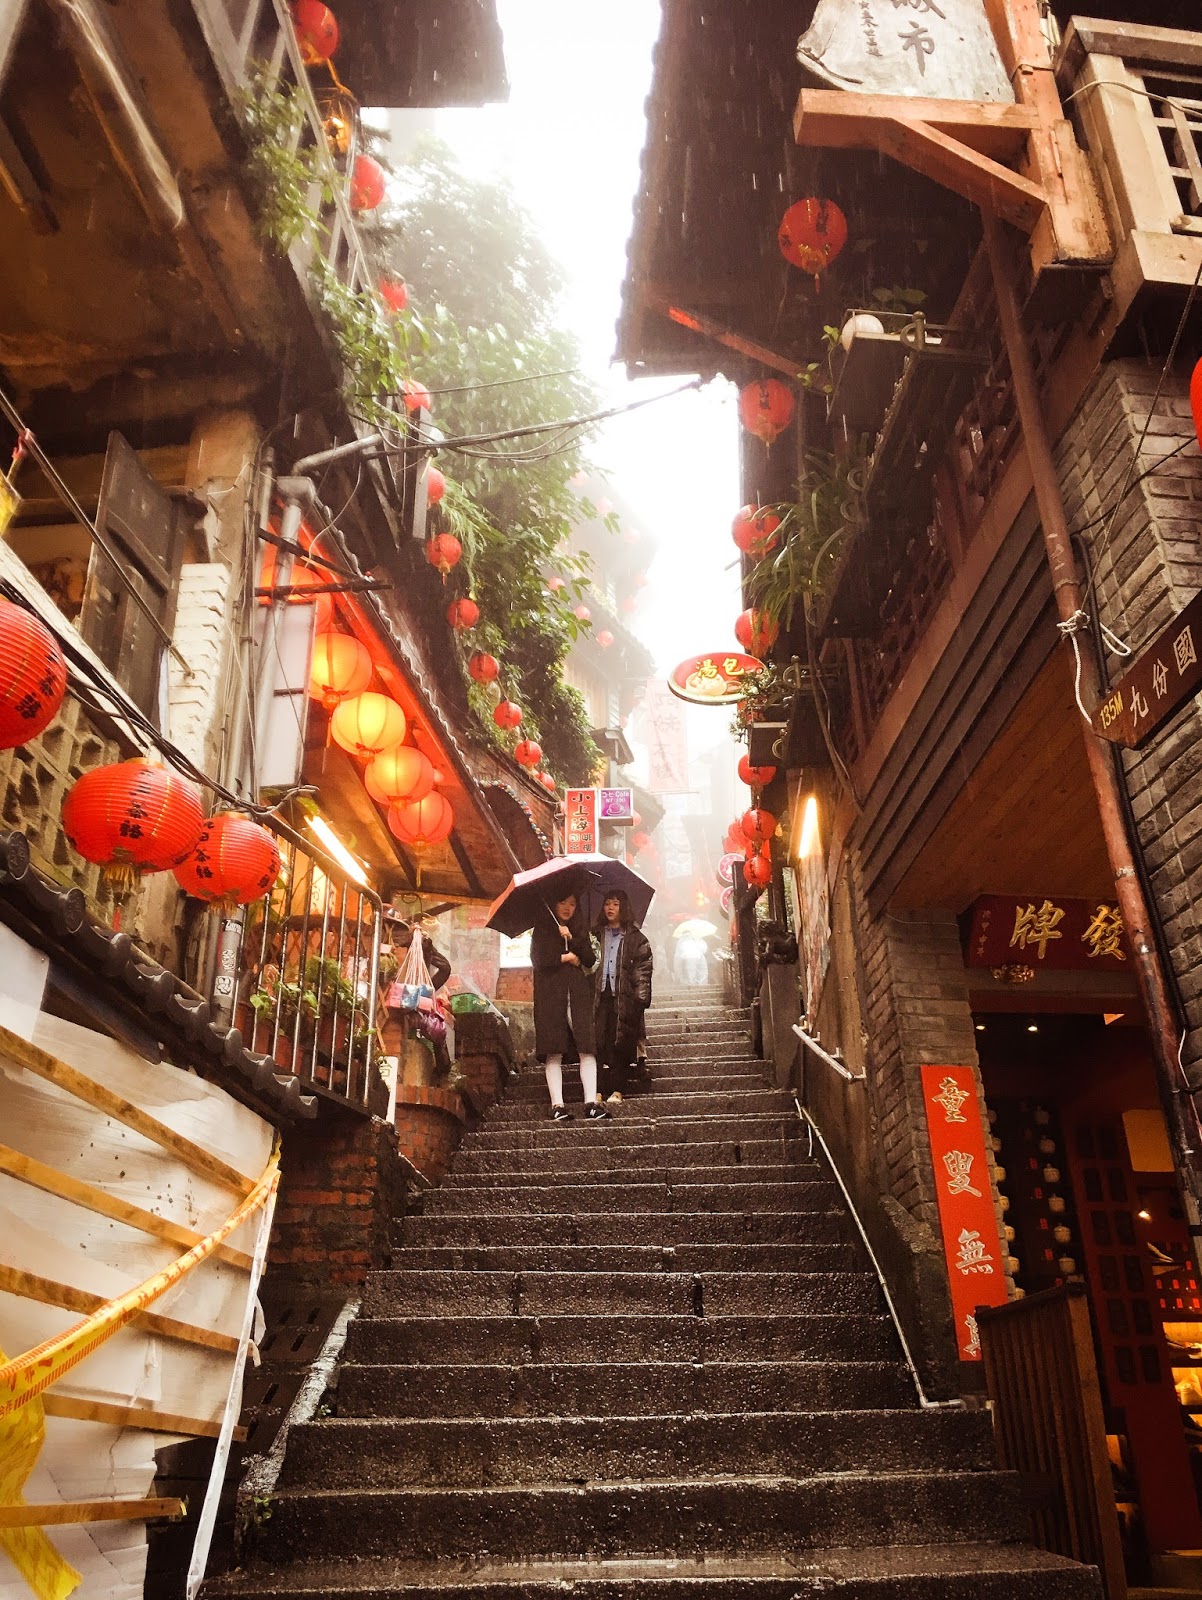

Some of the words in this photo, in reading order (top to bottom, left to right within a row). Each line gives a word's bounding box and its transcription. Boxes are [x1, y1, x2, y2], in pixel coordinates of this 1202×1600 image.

[695, 657, 745, 678] 湯包
[1129, 624, 1198, 728] 九份國
[1100, 691, 1124, 730] 135M
[572, 792, 591, 831] 小上海
